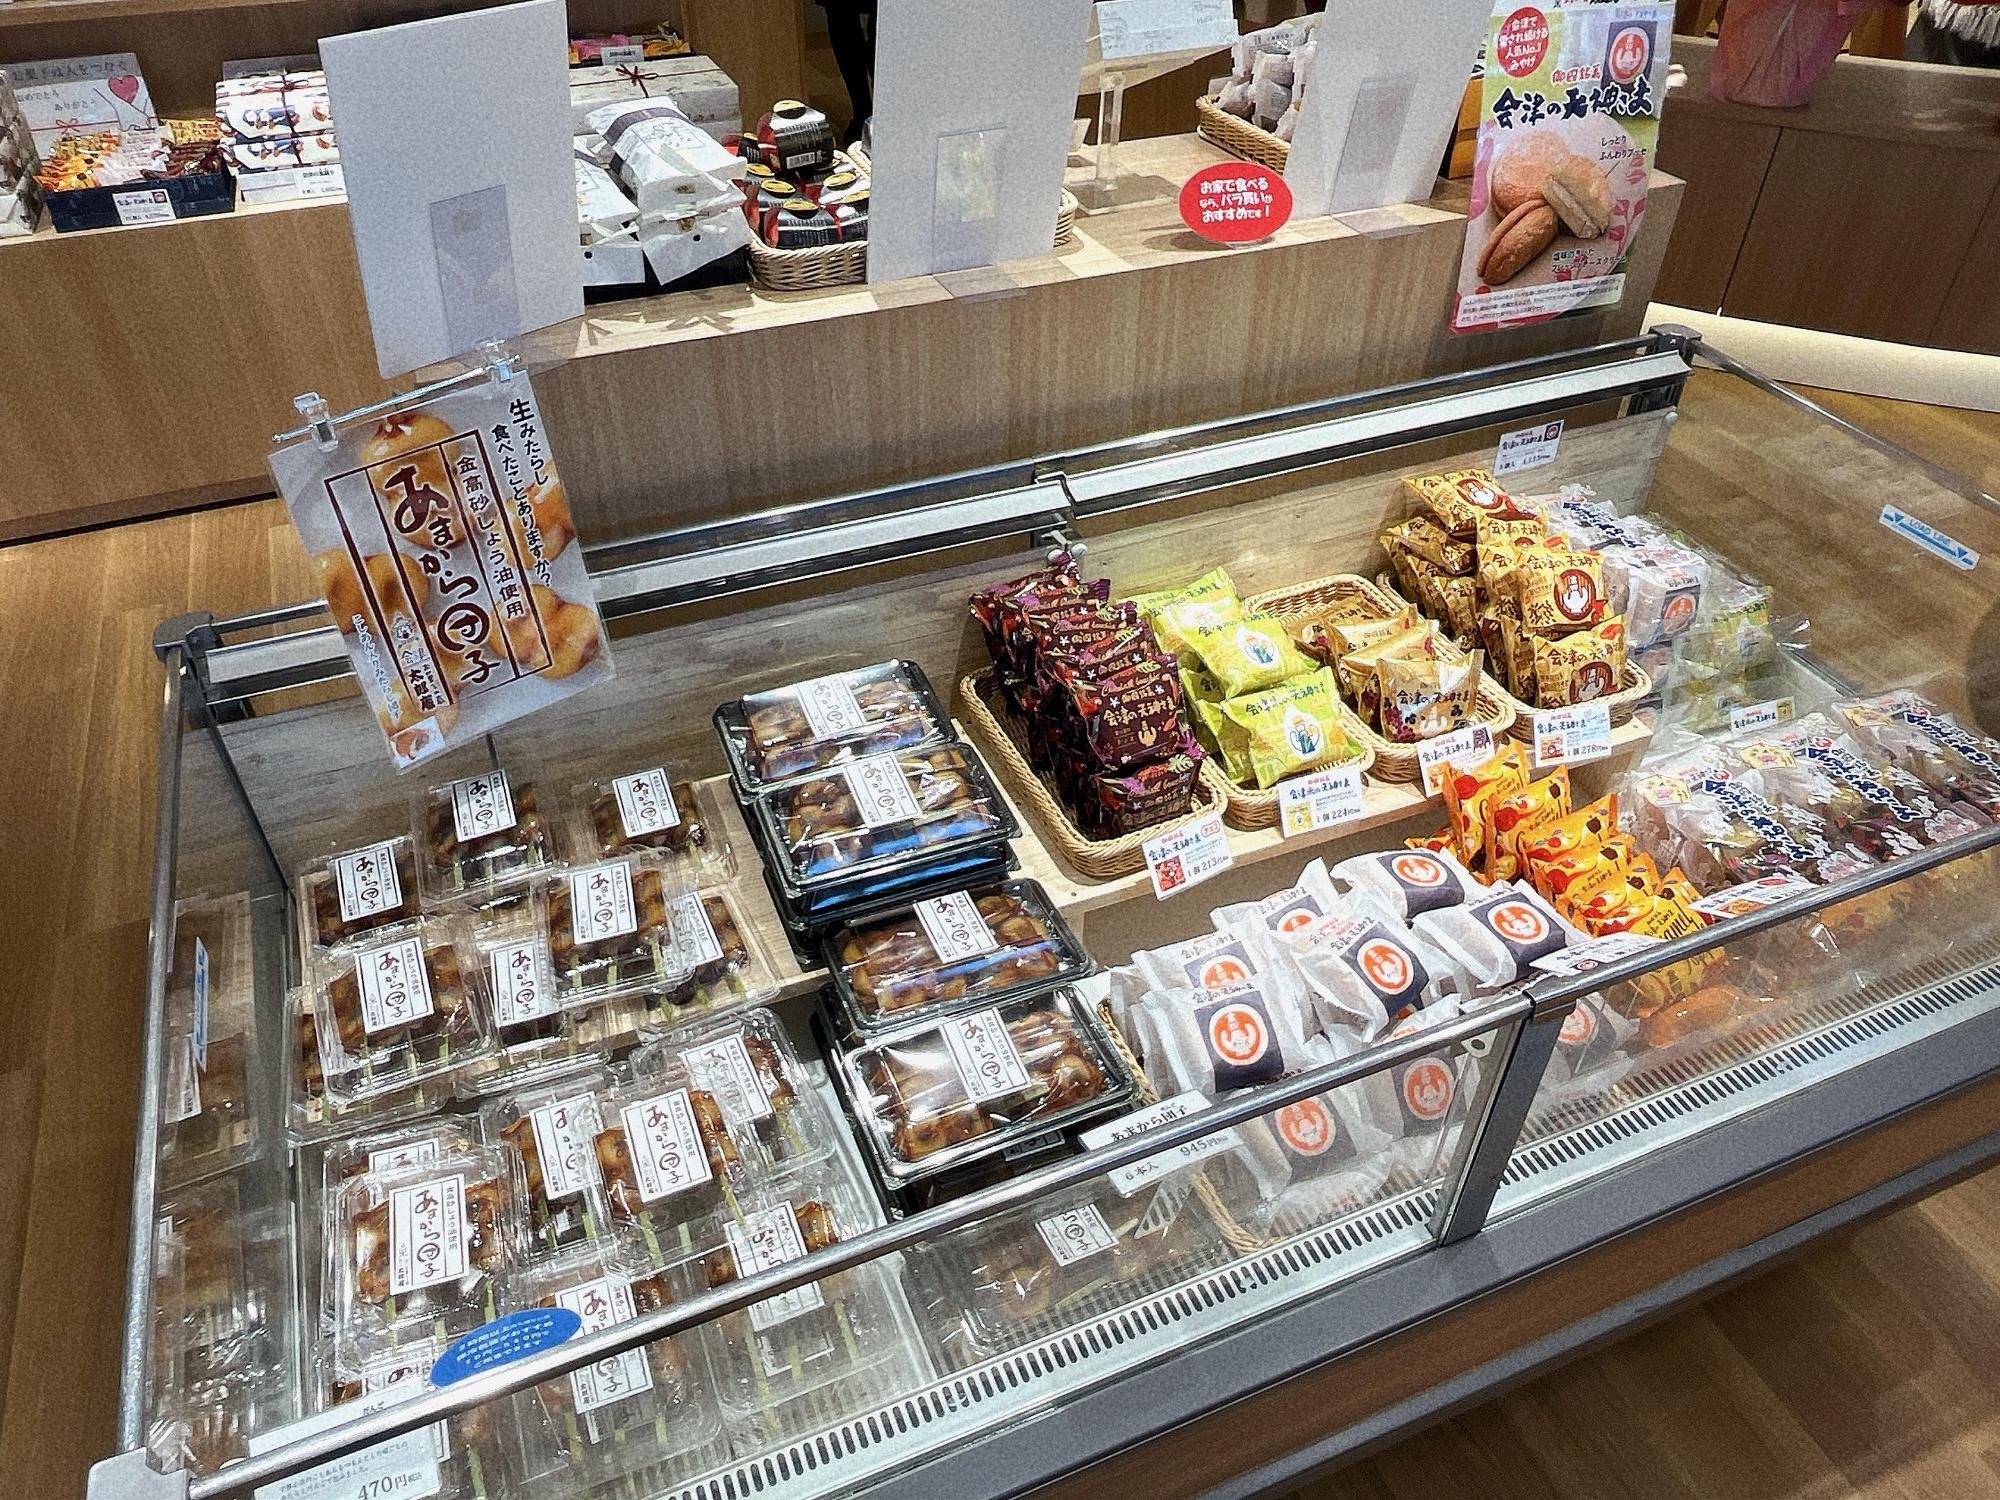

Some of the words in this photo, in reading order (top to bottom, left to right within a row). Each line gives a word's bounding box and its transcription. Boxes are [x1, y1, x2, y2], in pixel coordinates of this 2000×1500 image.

[1492, 75, 1652, 130] 会津の天神さま
[1601, 135, 1627, 146] しっとり
[1200, 177, 1269, 194] お家で食べる
[509, 398, 549, 485] 生みたらし
[457, 456, 525, 620] 金高砂しょう油使用
[1909, 519, 1931, 535] LOAD
[1103, 695, 1177, 726] 会津の天神さま
[1111, 1106, 1188, 1142] あまから団子
[646, 1105, 683, 1184] あまから団子
[1125, 1161, 1159, 1181] 6本入
[415, 1190, 440, 1278] あまから団子
